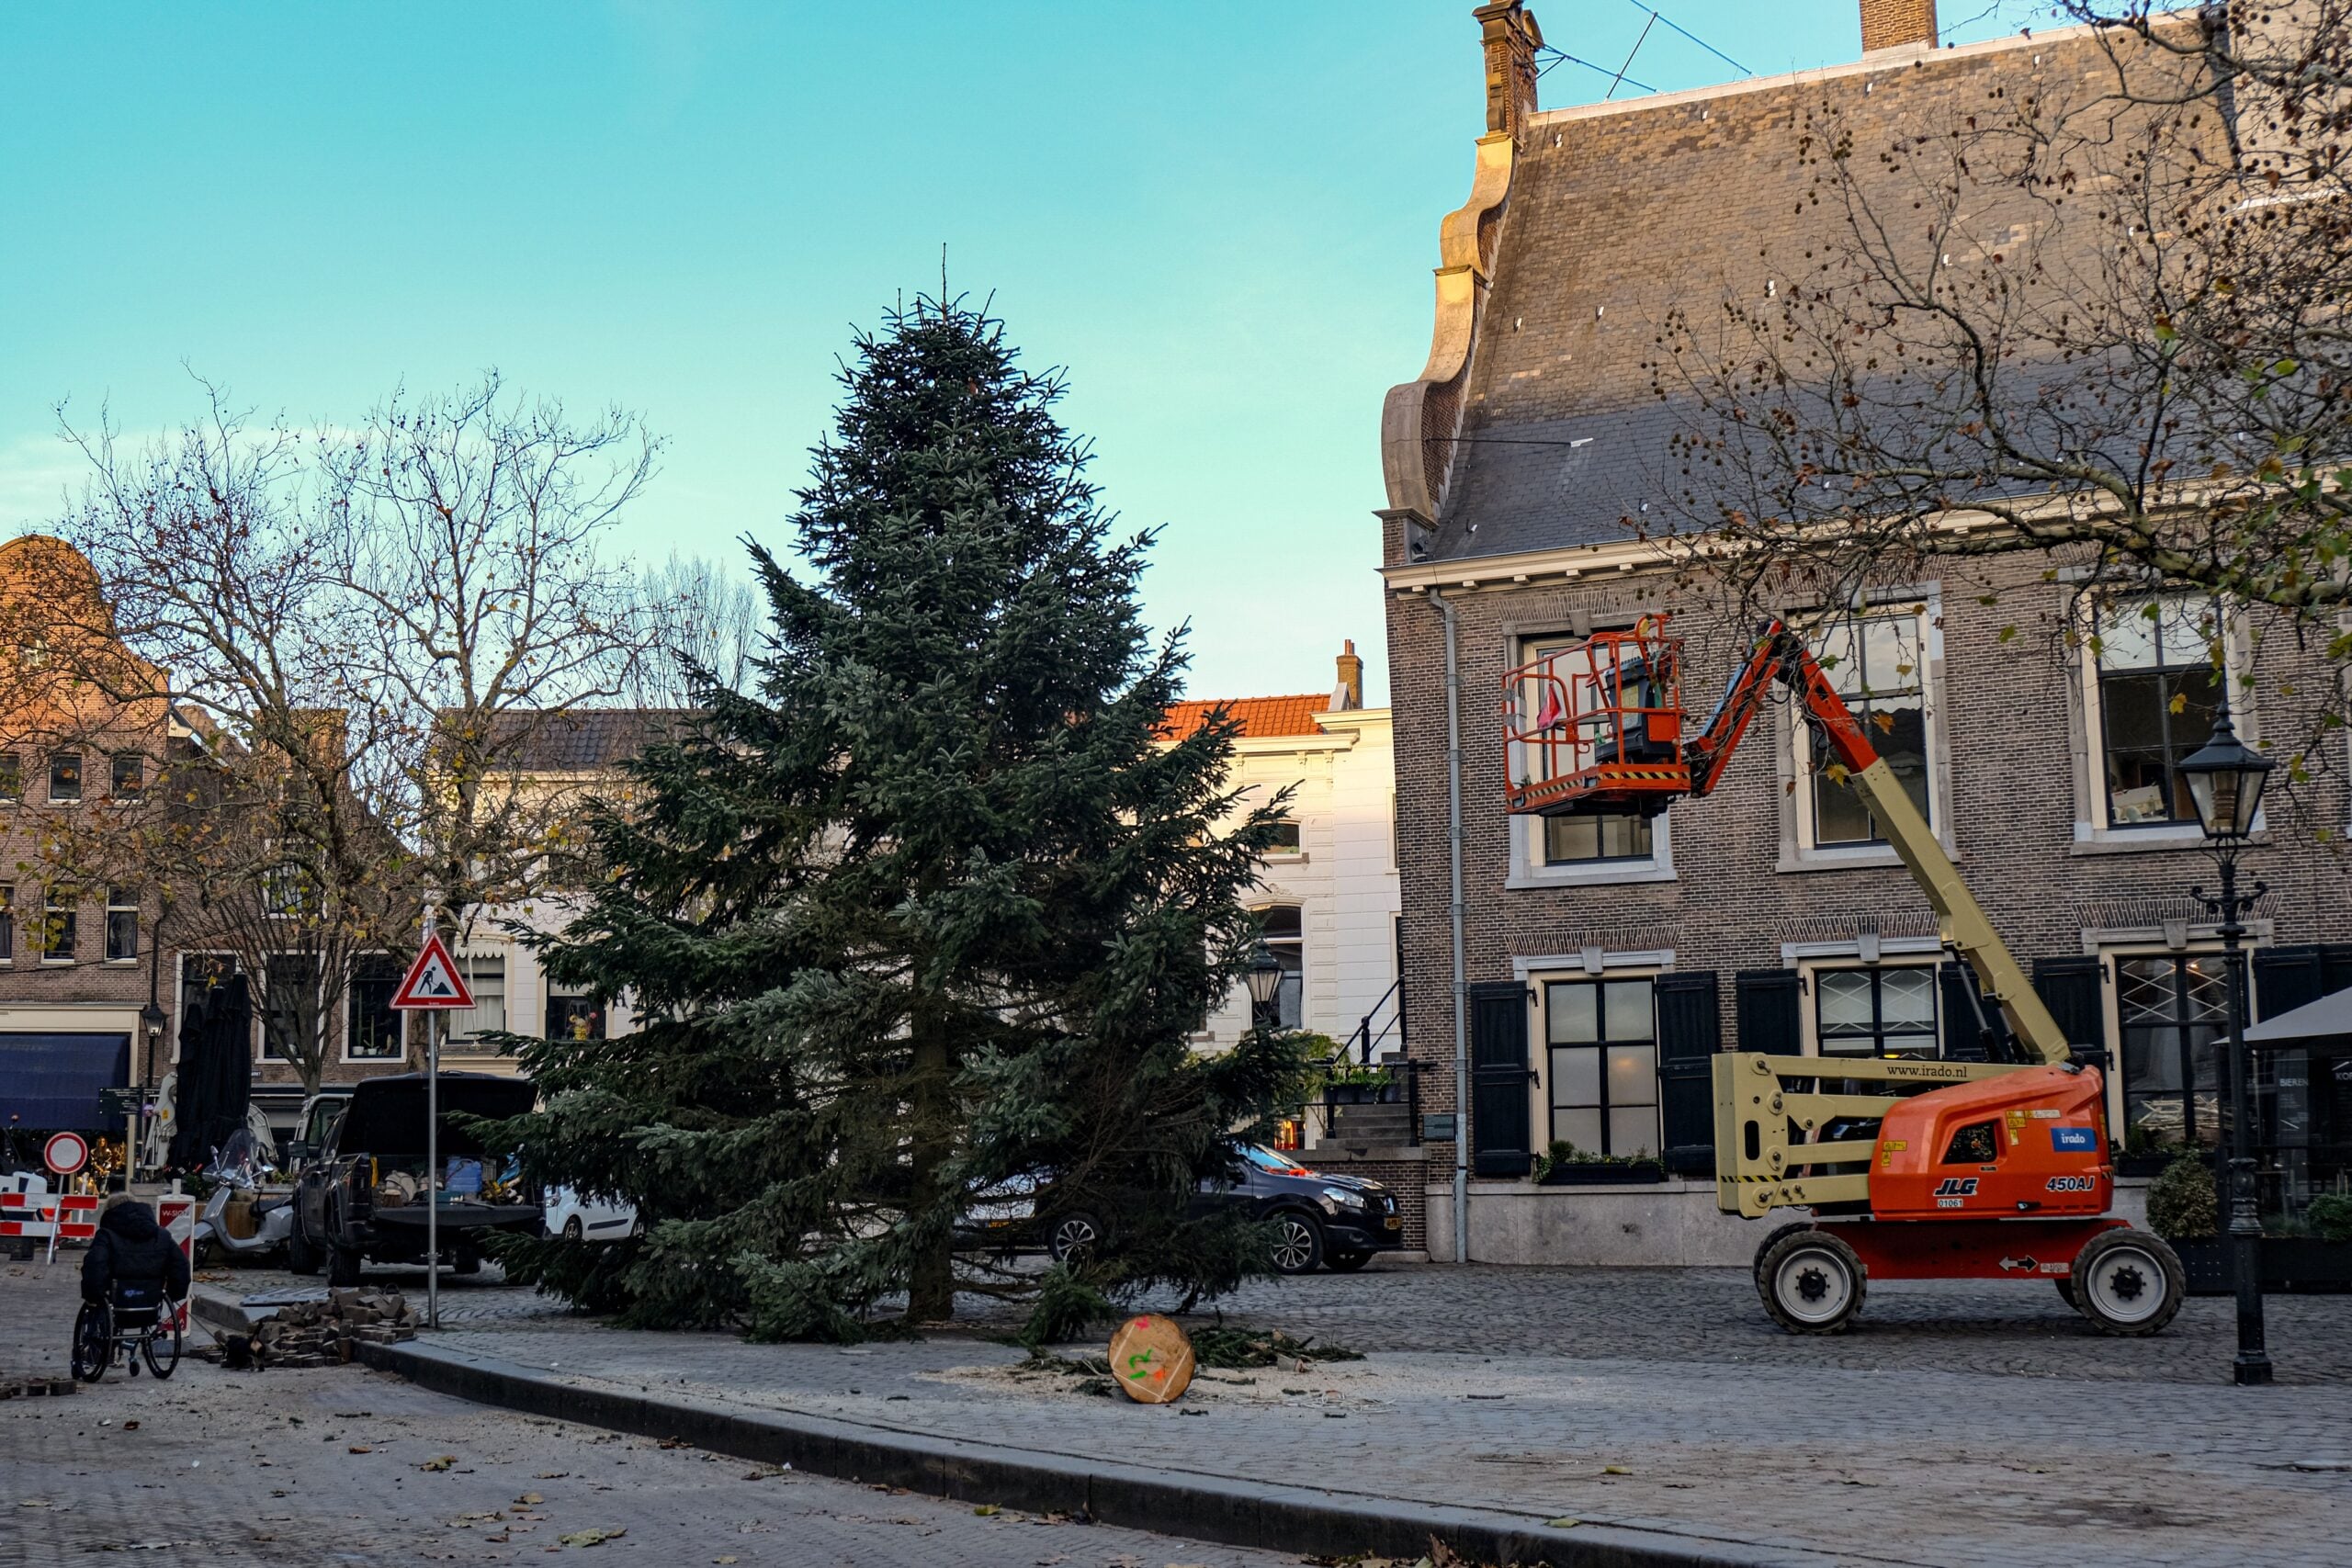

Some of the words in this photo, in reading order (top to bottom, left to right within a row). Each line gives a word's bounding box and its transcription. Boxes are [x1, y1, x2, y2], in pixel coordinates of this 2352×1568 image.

[1887, 1065, 1967, 1077] www.irado.nl
[2279, 1078, 2309, 1087] BIEREN
[2061, 1134, 2086, 1144] irado
[1934, 1178, 1978, 1195] JLG
[2046, 1176, 2095, 1191] 450AJ
